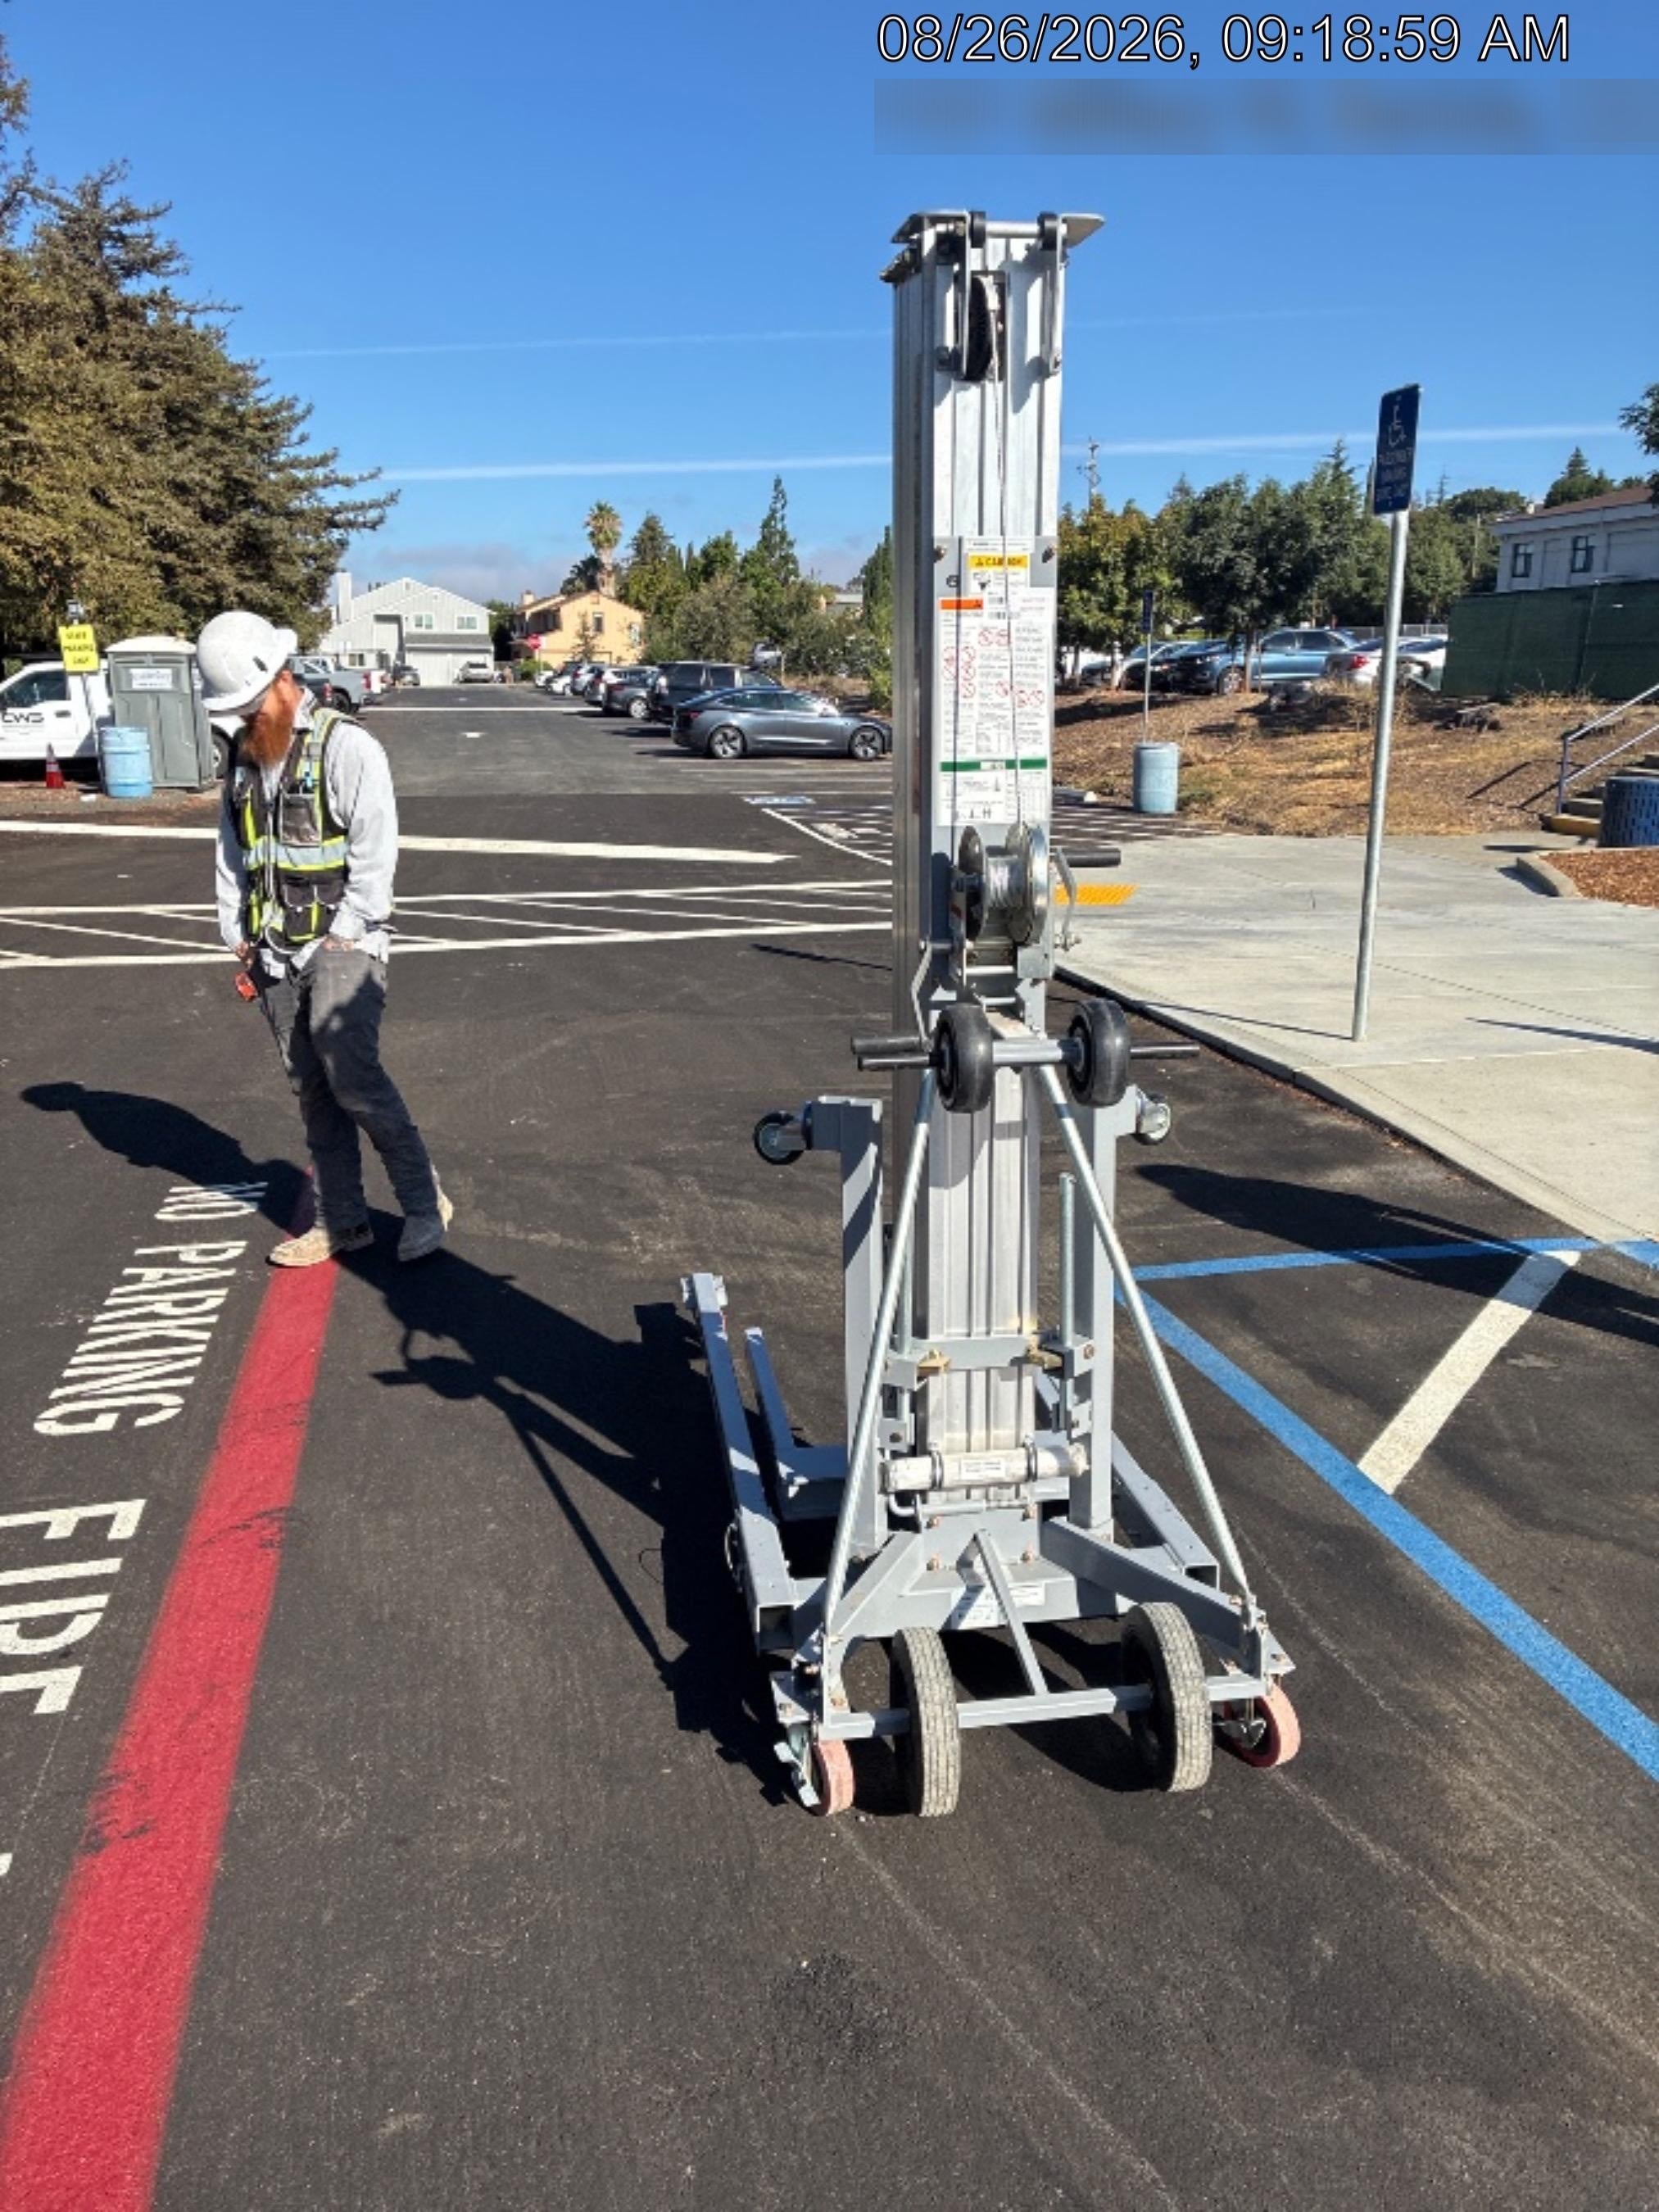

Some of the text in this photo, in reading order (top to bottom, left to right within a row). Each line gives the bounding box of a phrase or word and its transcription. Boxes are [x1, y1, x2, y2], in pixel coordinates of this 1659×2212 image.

[986, 556, 1022, 565] CAUION
[154, 1181, 269, 1222] NO
[34, 1240, 248, 1435] PARKING
